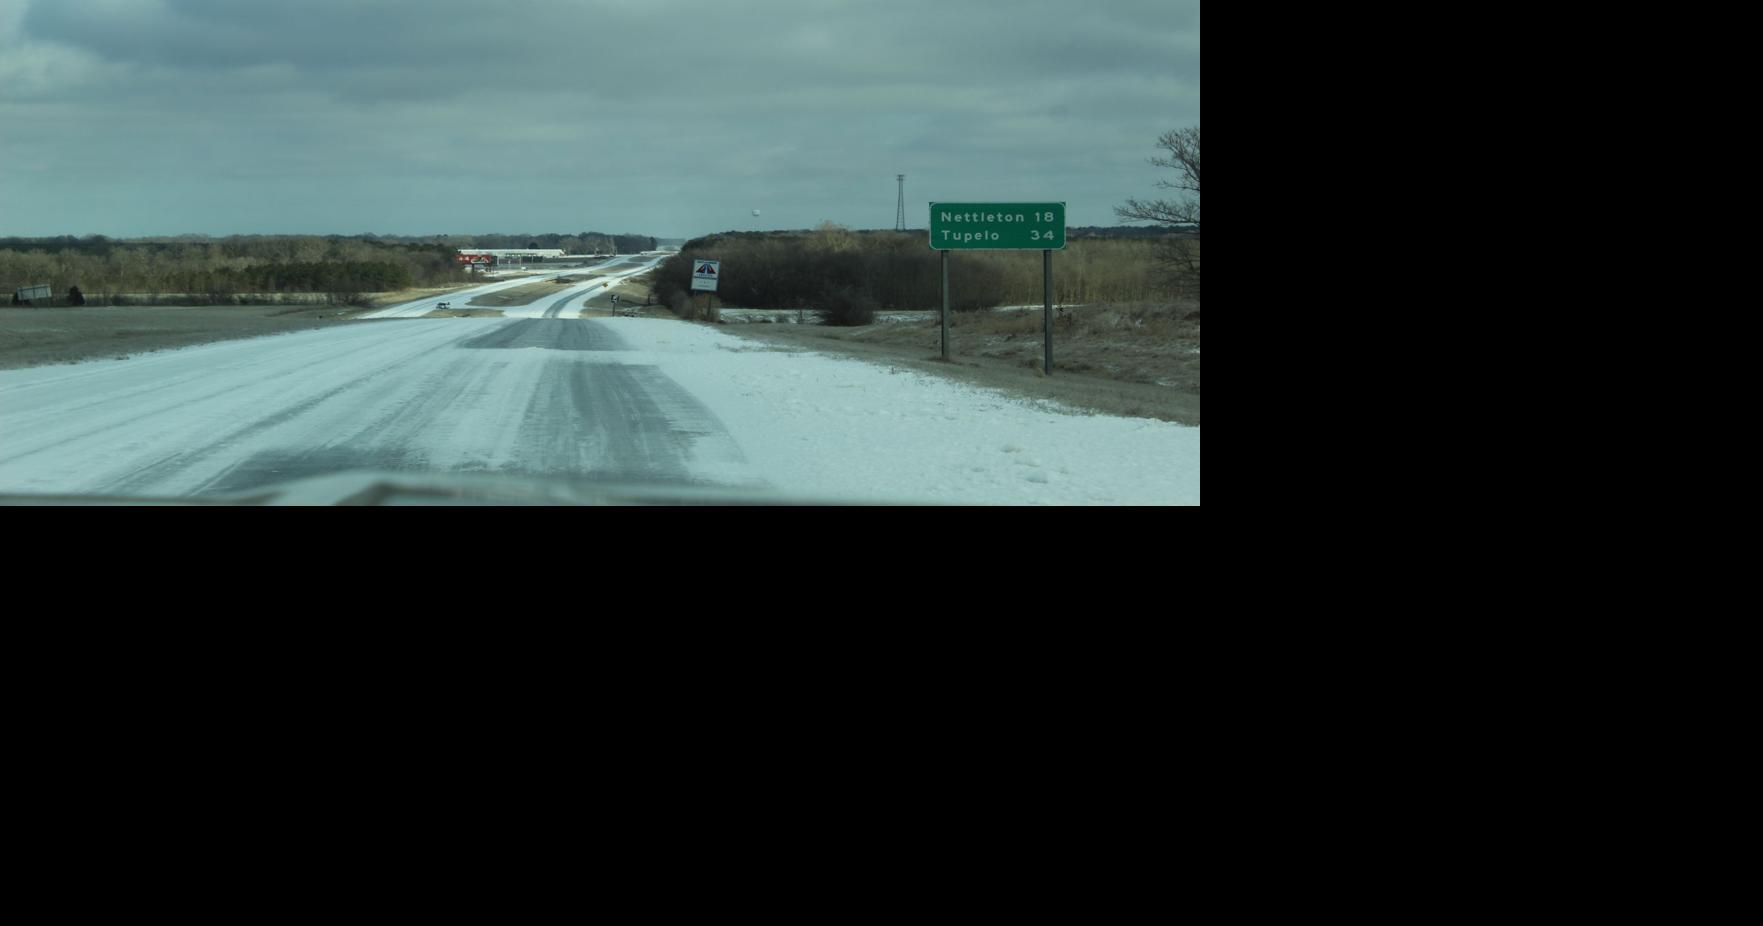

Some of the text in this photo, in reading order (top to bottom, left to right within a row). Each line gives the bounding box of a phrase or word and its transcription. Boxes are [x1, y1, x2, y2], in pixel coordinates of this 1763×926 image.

[941, 211, 1054, 222] Nettleton 18
[941, 229, 1054, 243] Tupelo 34
